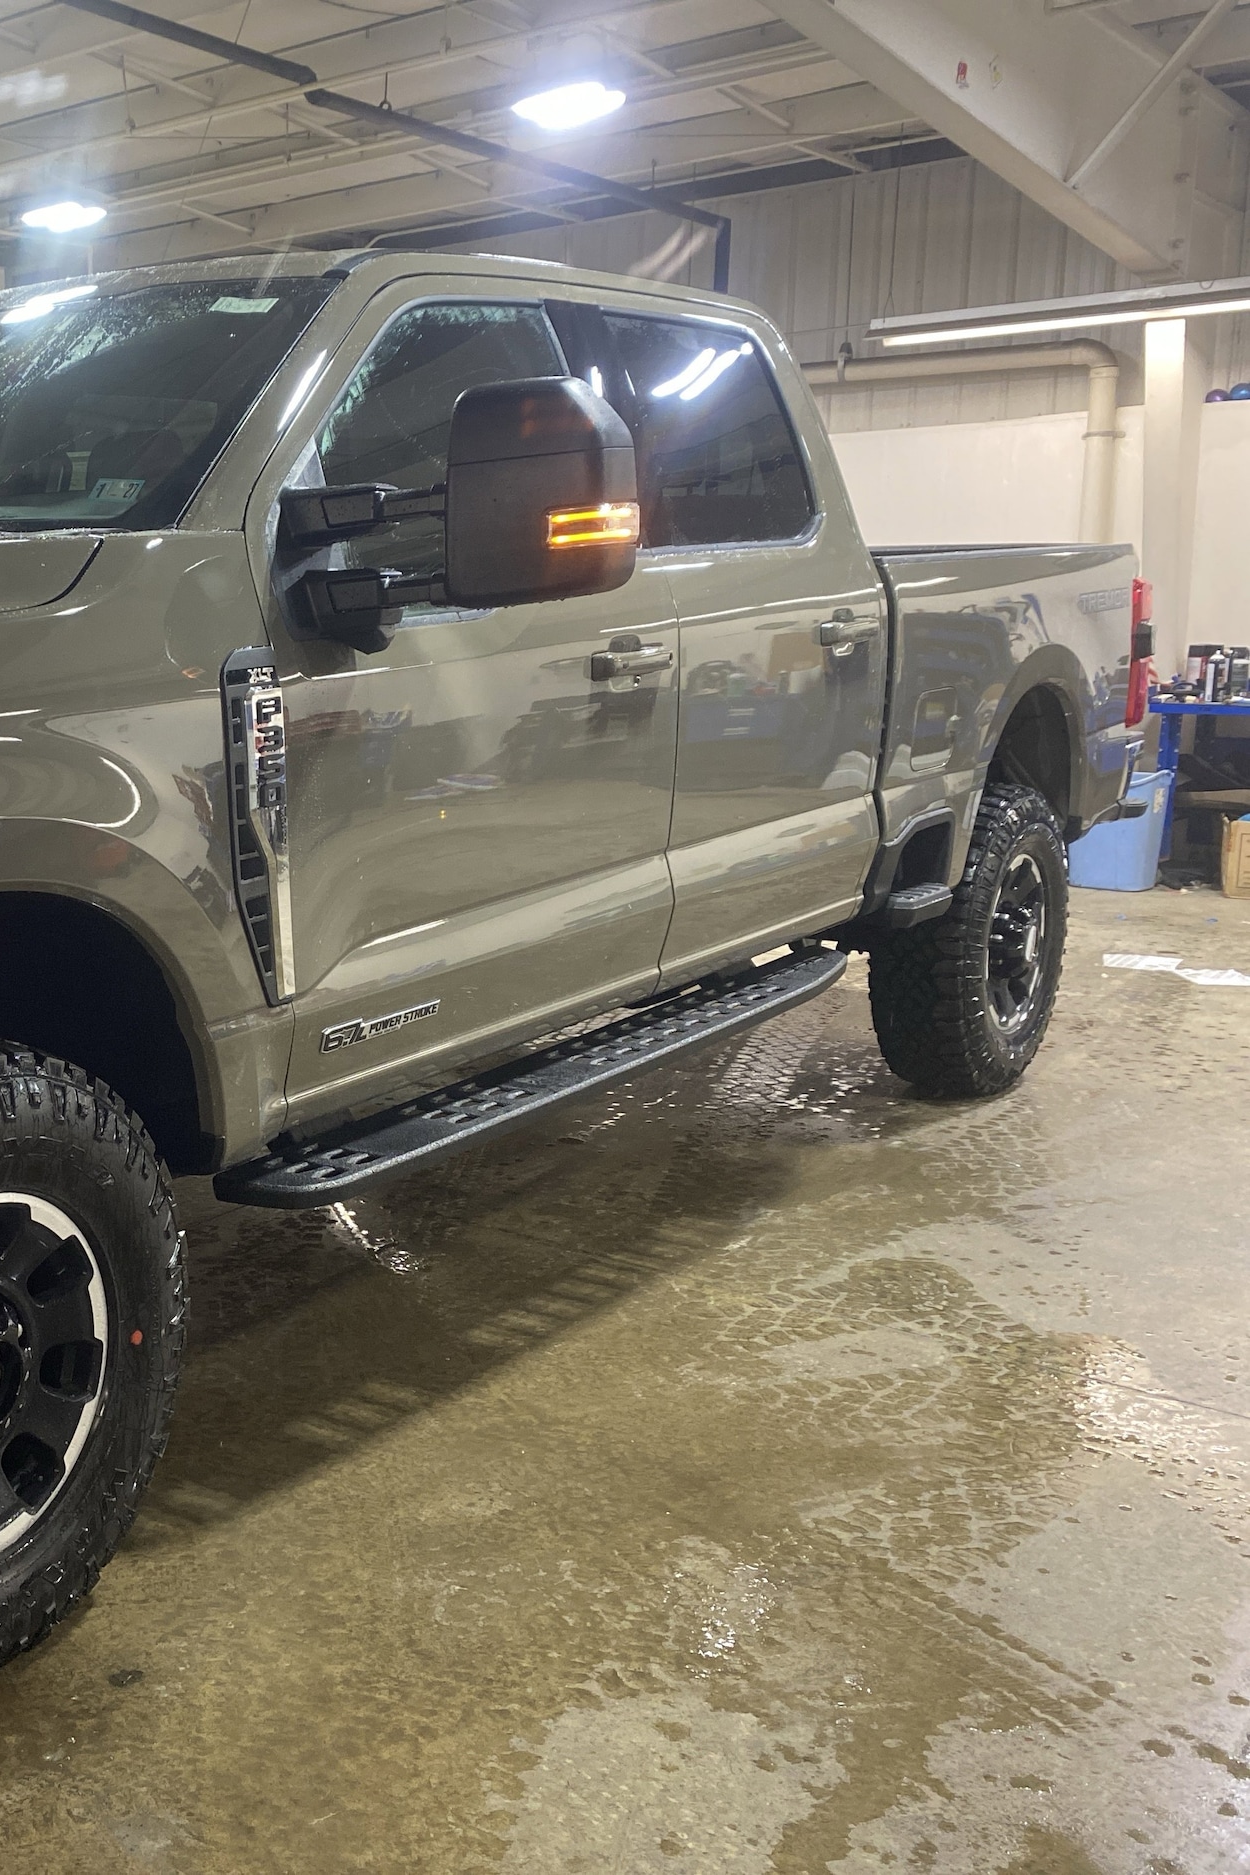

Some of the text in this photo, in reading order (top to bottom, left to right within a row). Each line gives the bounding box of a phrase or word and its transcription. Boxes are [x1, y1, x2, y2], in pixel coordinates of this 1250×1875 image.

[123, 483, 140, 499] 27
[1080, 589, 1129, 612] TREMOR
[247, 667, 274, 683] XLT
[322, 1021, 367, 1051] 6.7L
[369, 1015, 401, 1034] POWER
[403, 1003, 439, 1023] STROKE
